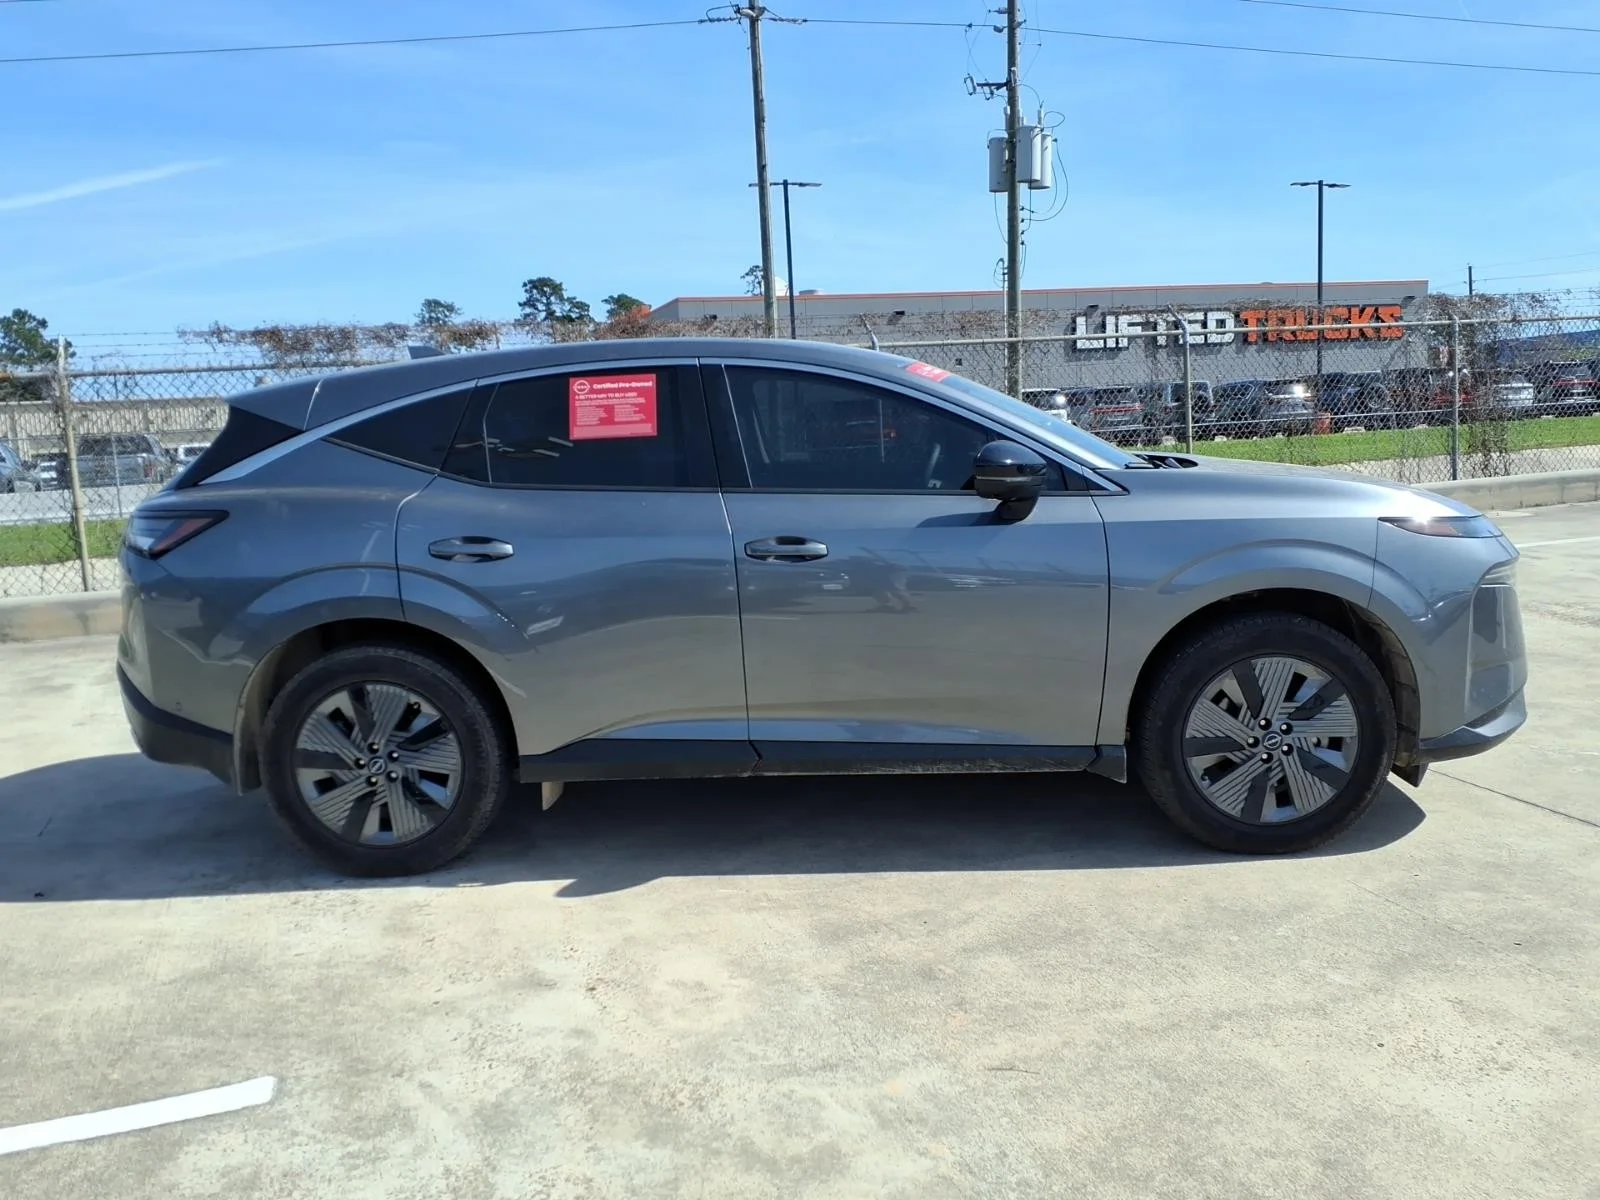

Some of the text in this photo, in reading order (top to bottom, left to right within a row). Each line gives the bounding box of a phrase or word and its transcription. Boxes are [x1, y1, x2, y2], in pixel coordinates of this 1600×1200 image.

[1076, 305, 1403, 349] LIFTED TRUCKS
[593, 382, 618, 390] Certified
[619, 380, 653, 388] Pre-Owned
